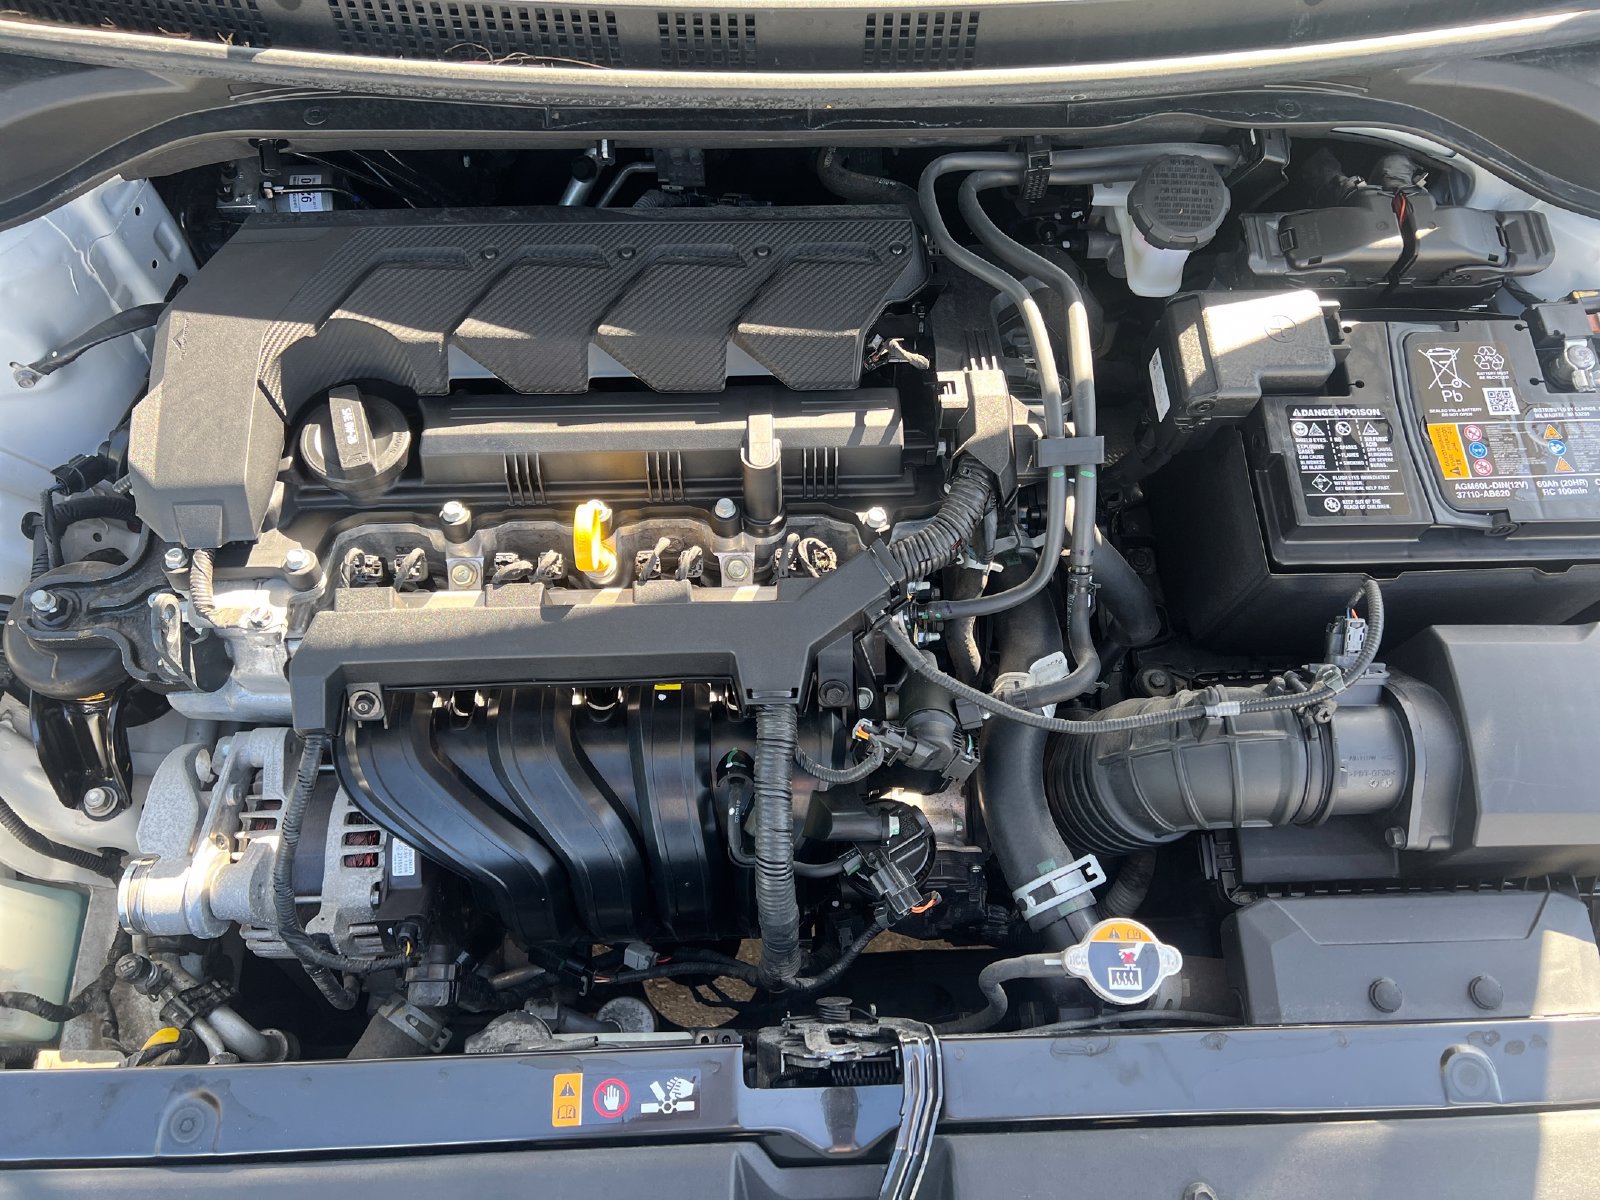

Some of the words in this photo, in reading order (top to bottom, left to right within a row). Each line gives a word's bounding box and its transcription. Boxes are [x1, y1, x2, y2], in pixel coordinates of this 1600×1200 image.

[1441, 390, 1463, 402] Pb
[1301, 408, 1381, 417] DANGER/POISON
[1536, 480, 1559, 488] 60Ah
[1560, 478, 1589, 488] (20HR)
[1543, 488, 1556, 496] RC
[1558, 487, 1588, 496] 100min
